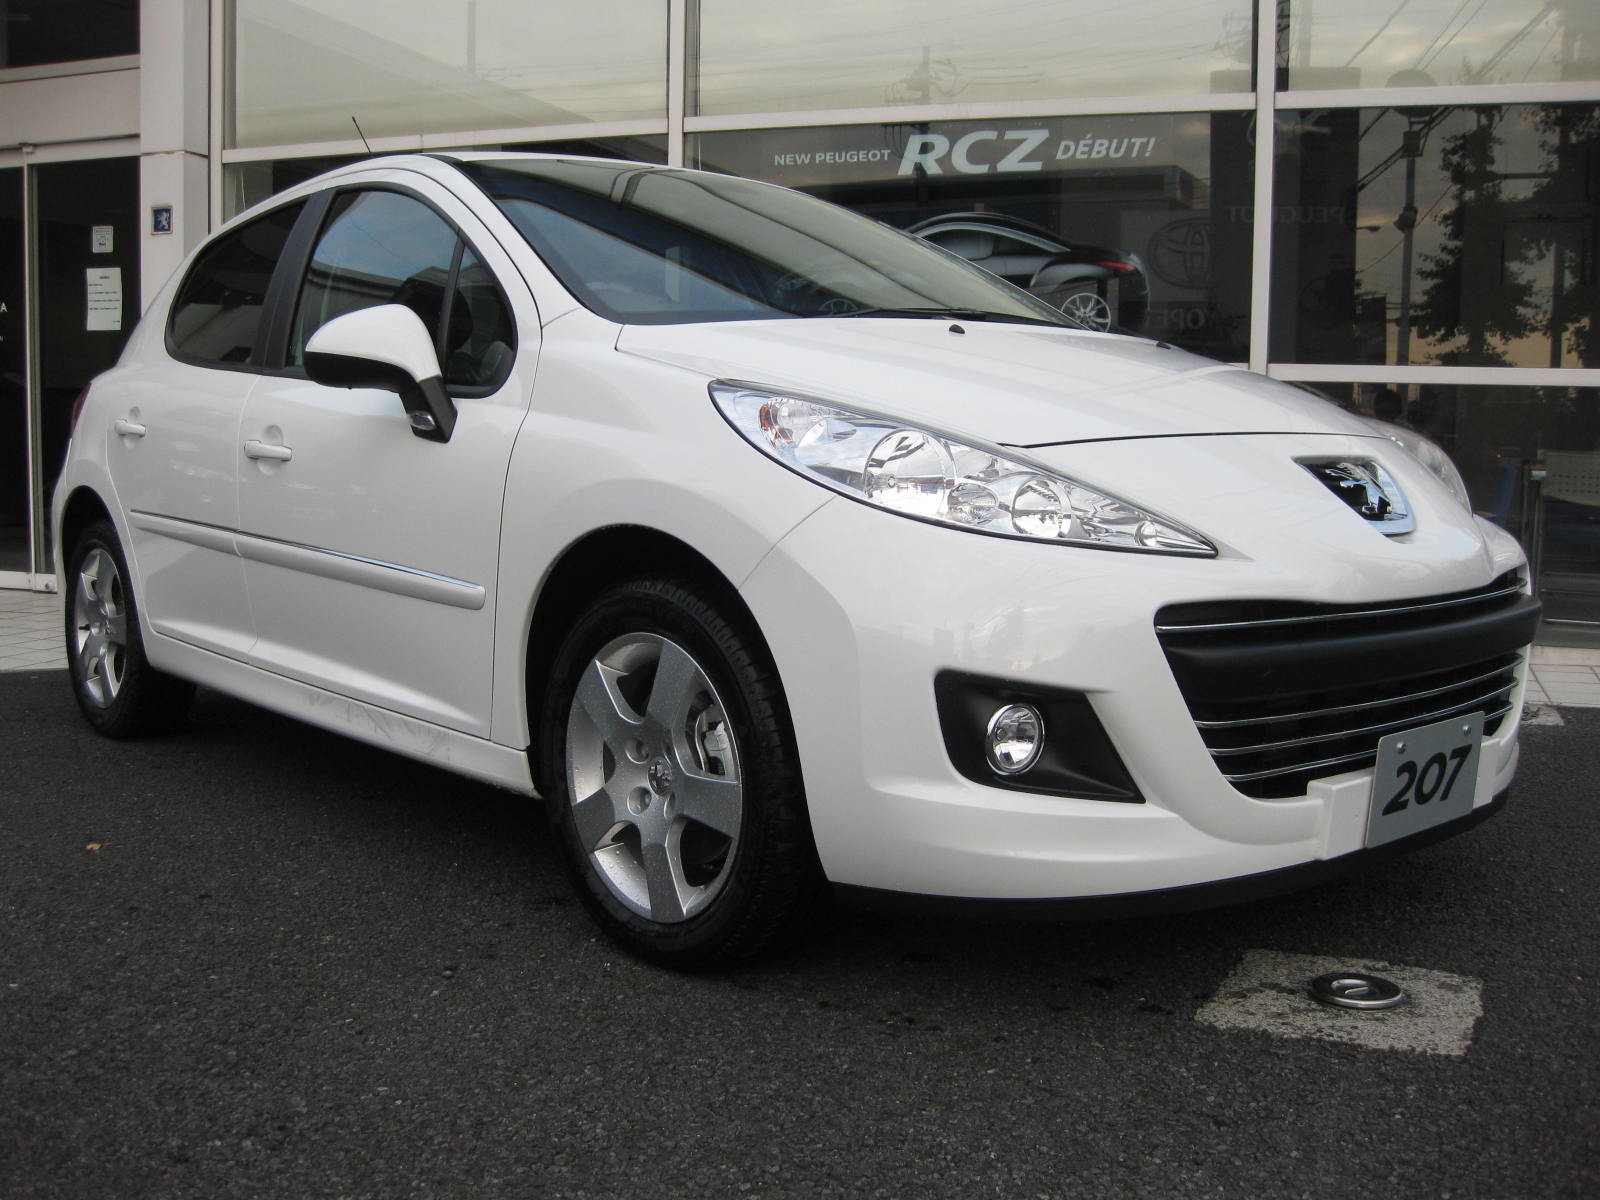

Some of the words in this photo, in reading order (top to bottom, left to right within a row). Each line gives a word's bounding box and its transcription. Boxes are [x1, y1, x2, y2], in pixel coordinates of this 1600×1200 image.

[774, 154, 811, 166] NEW
[815, 149, 891, 164] PEUGEOT
[898, 129, 1050, 176] RCZ
[1056, 134, 1156, 160] DÉBUT!
[1382, 744, 1472, 817] 207
